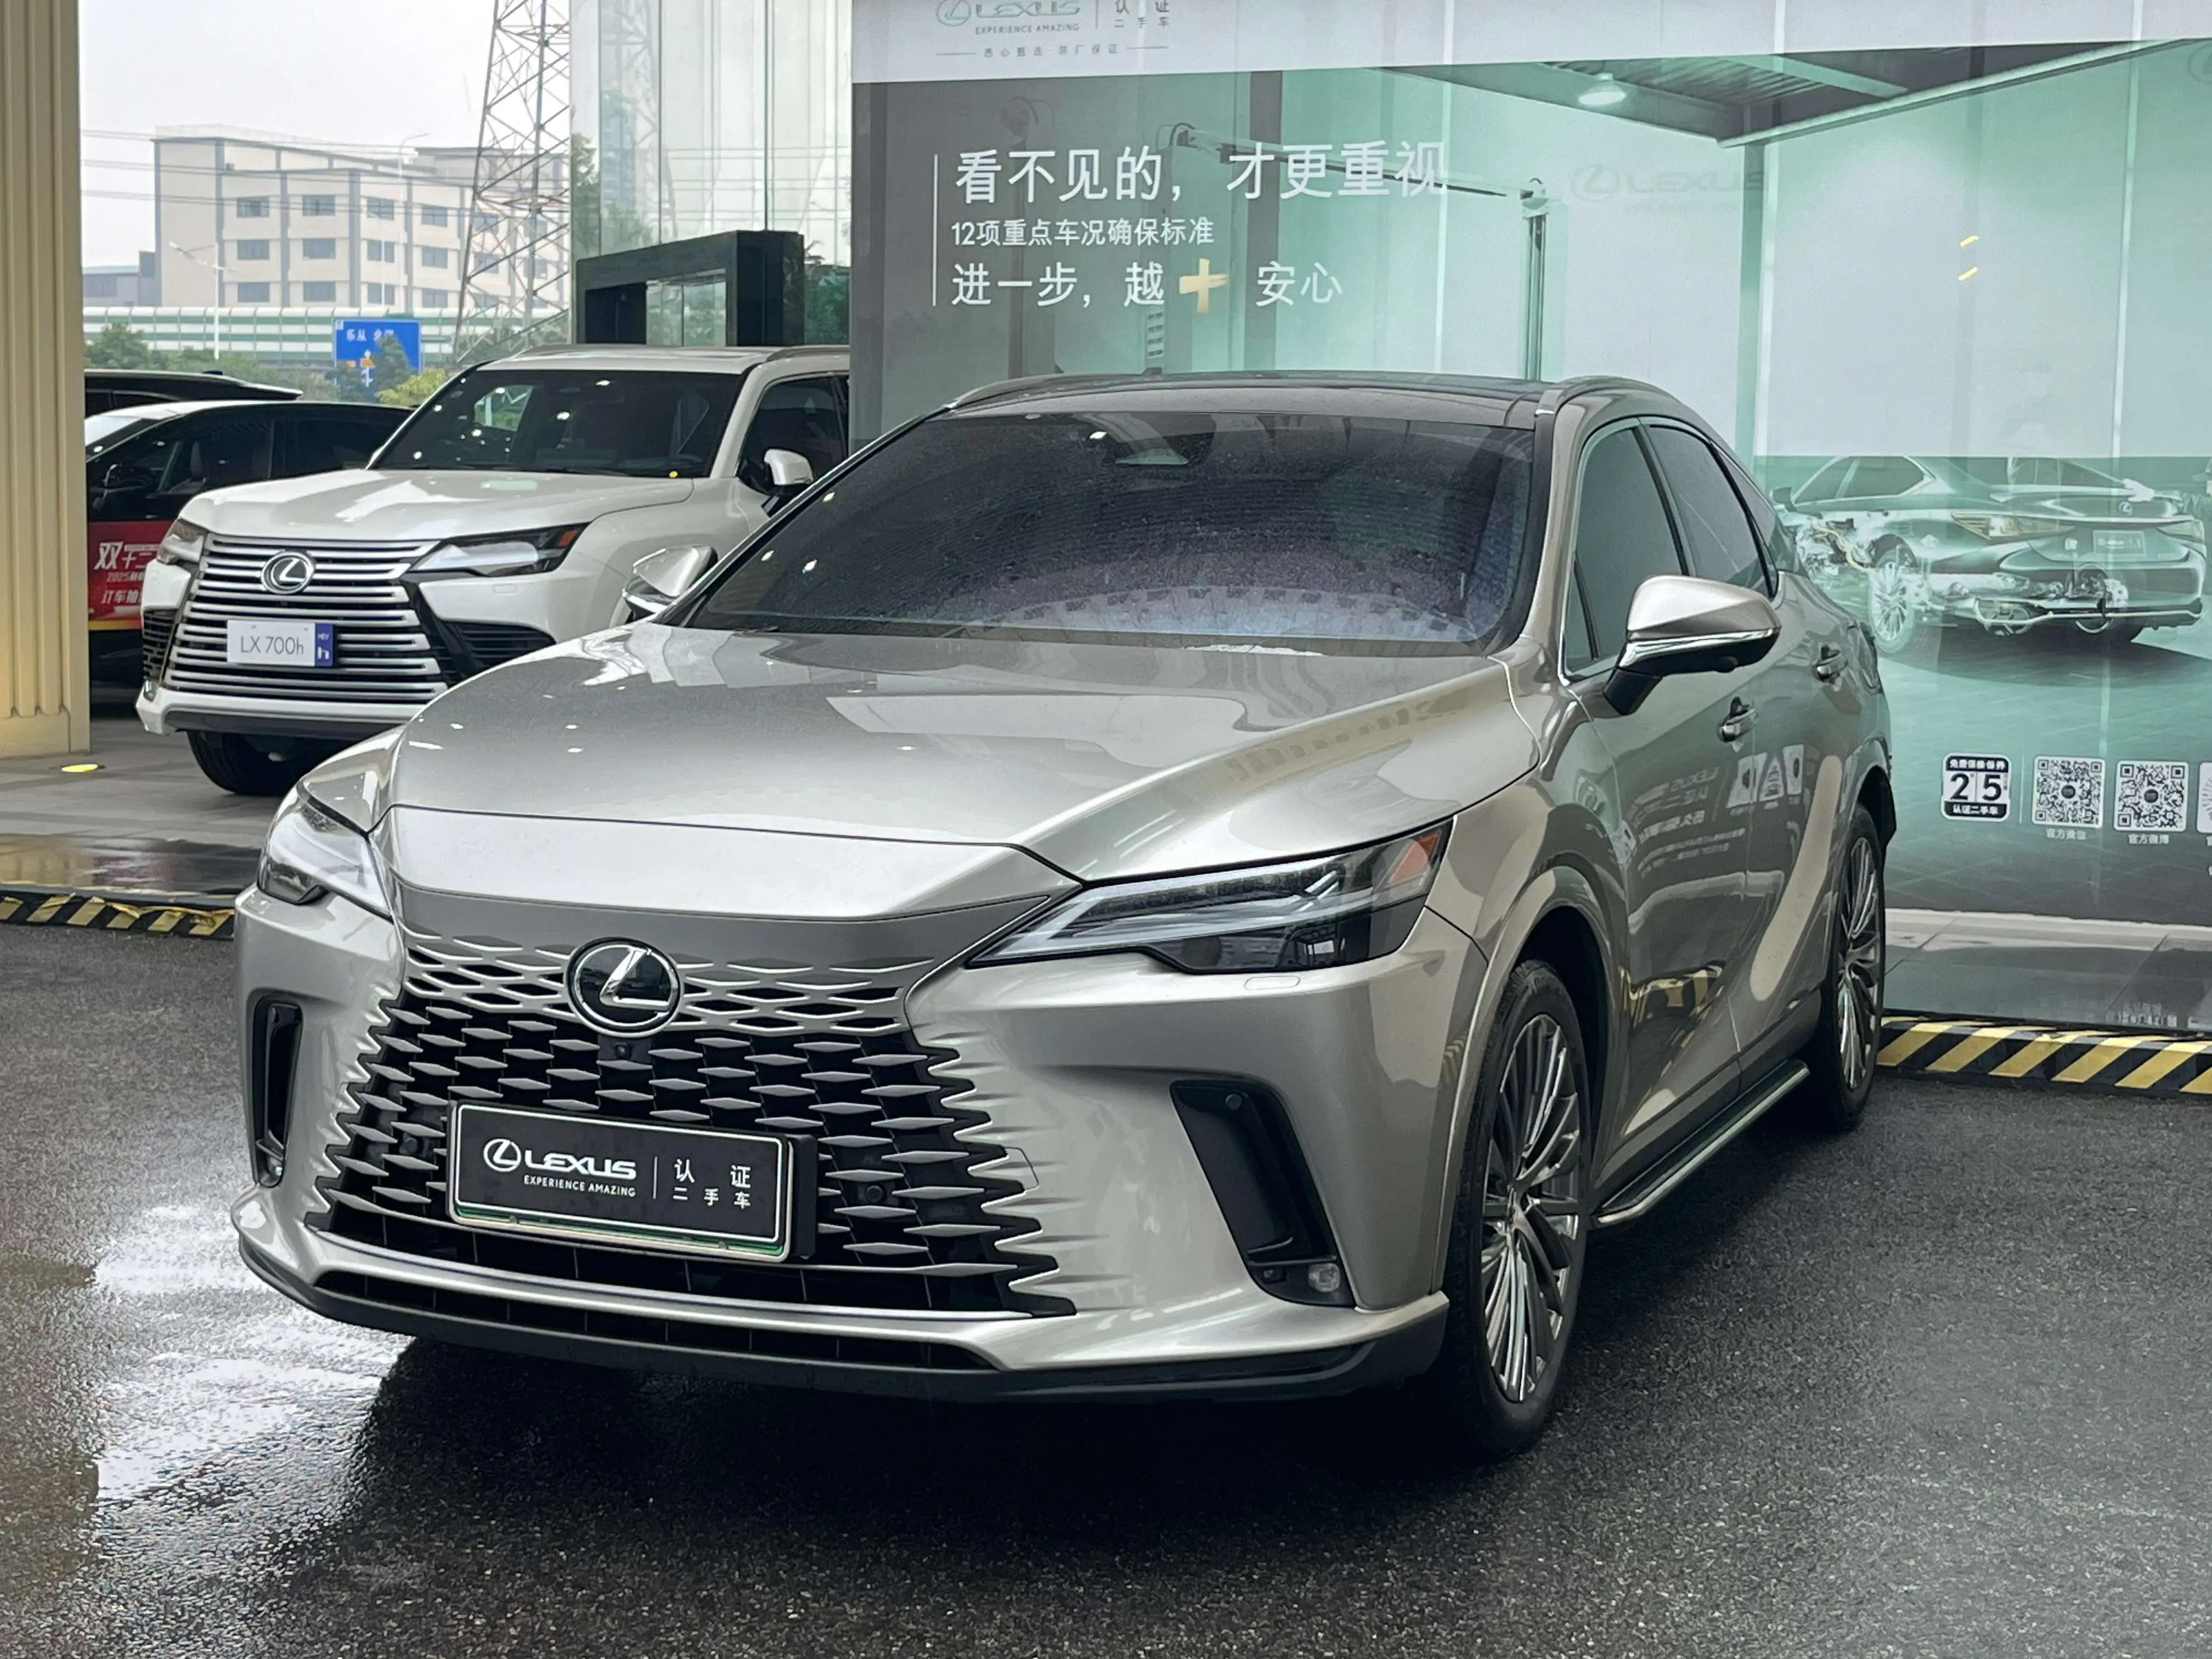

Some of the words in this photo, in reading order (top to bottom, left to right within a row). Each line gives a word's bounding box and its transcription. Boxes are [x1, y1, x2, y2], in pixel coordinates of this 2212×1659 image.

[975, 0, 1080, 18] LEXUS
[975, 25, 1032, 35] EXPERIENCE
[1036, 23, 1080, 32] AMAZING
[1113, 16, 1170, 30] 二手车
[951, 216, 1214, 247] 12项重点车况确保标准
[240, 635, 262, 654] LX
[265, 636, 304, 655] 700h
[317, 646, 330, 660] h
[1950, 773, 1970, 800] 2
[1982, 774, 2002, 801] 5
[525, 1150, 637, 1180] LEXUS
[674, 1159, 752, 1189] 认证
[524, 1175, 585, 1192] EXPERIENCE
[588, 1183, 636, 1198] AMAZING
[673, 1186, 752, 1209] 二手车
